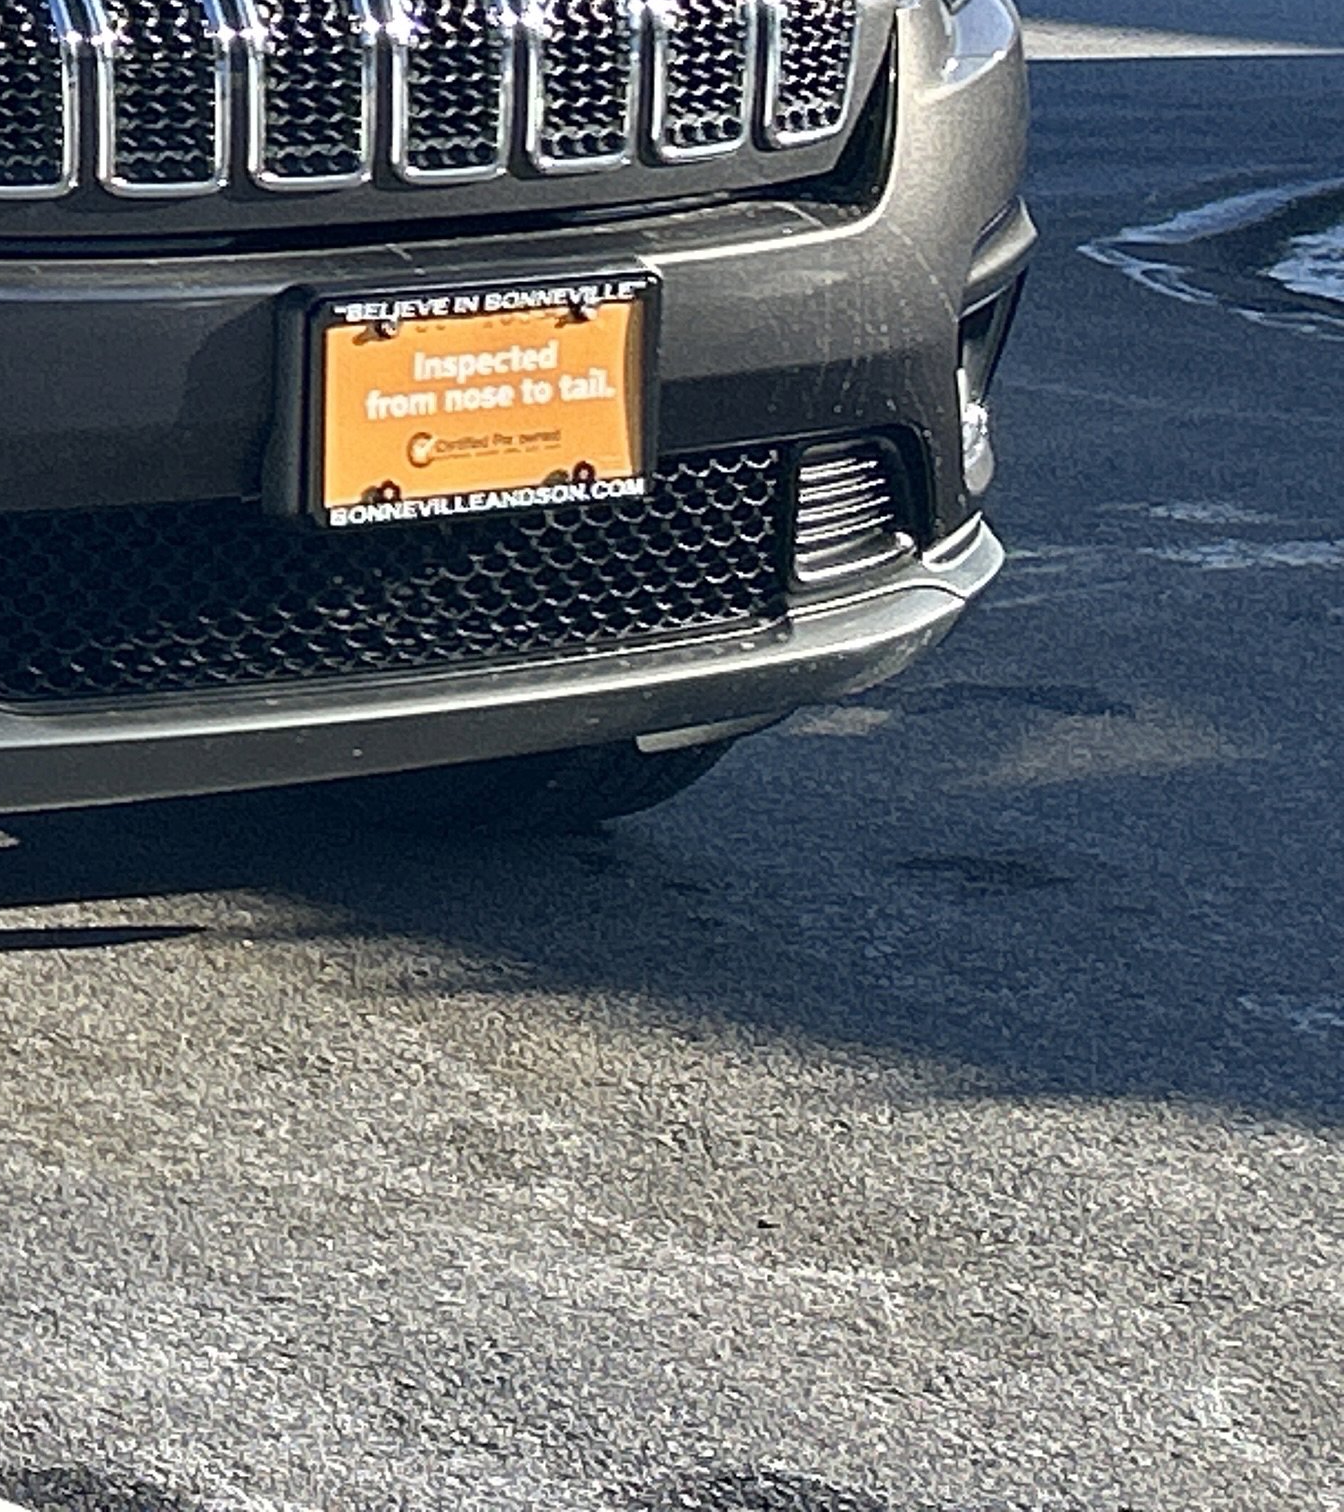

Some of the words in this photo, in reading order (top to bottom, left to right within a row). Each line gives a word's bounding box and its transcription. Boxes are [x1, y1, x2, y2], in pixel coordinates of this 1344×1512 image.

[454, 294, 479, 314] IN
[414, 339, 559, 384] Inspected
[365, 390, 437, 420] from
[444, 384, 515, 413] nose
[520, 377, 553, 405] to
[559, 367, 617, 402] tail.
[329, 477, 645, 527] BONNEVILLEANDSON.COM
